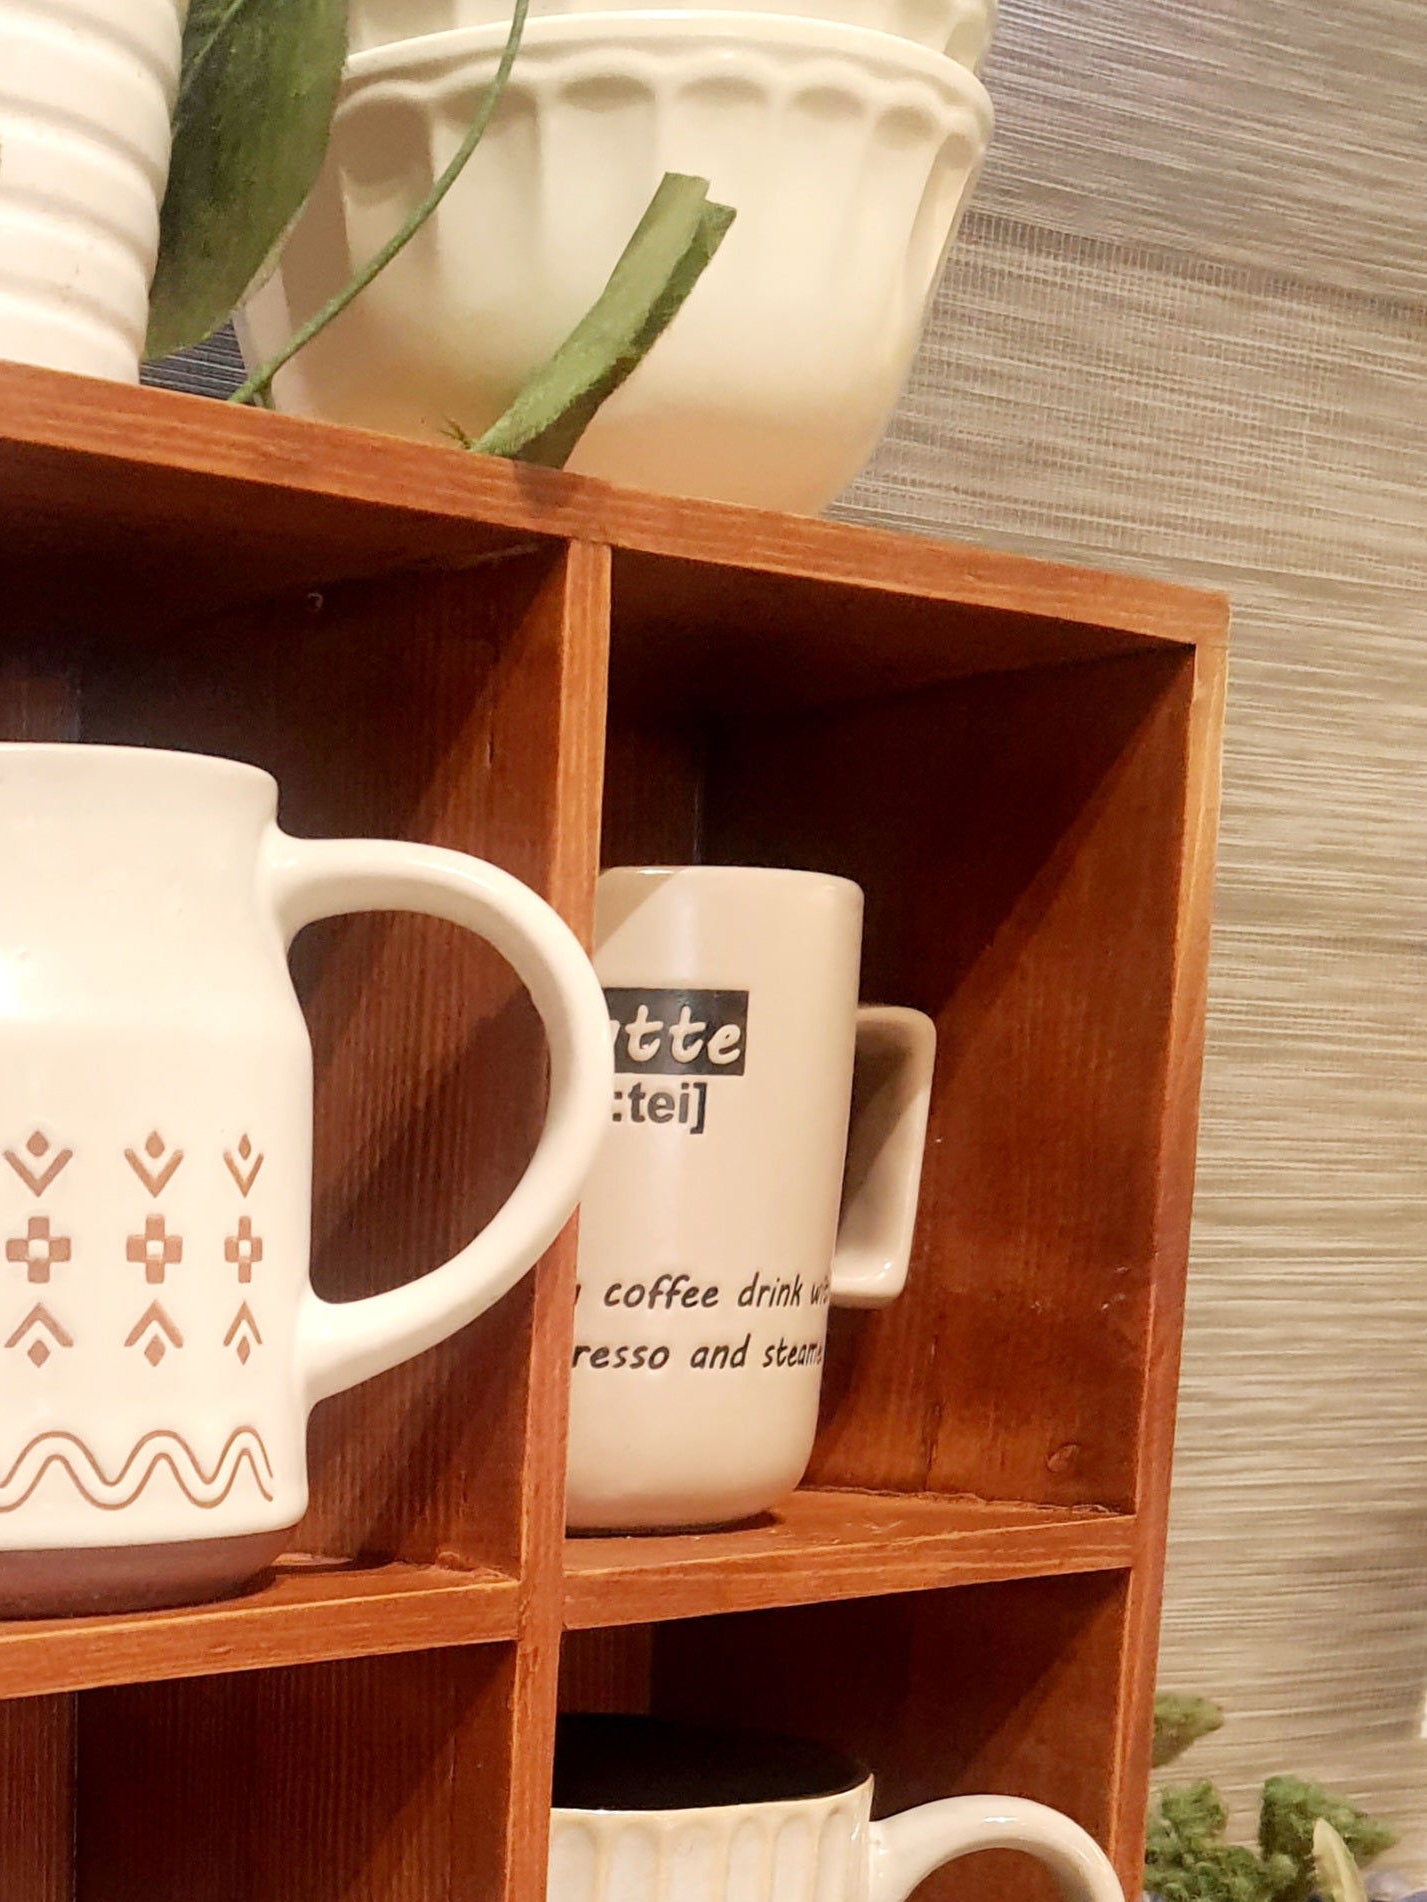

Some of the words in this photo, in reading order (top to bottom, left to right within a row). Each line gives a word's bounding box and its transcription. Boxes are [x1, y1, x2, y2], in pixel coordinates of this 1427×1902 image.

[604, 1274, 719, 1309] coffee
[738, 1271, 804, 1308] drink
[572, 1344, 670, 1369] resso
[690, 1333, 751, 1369] and
